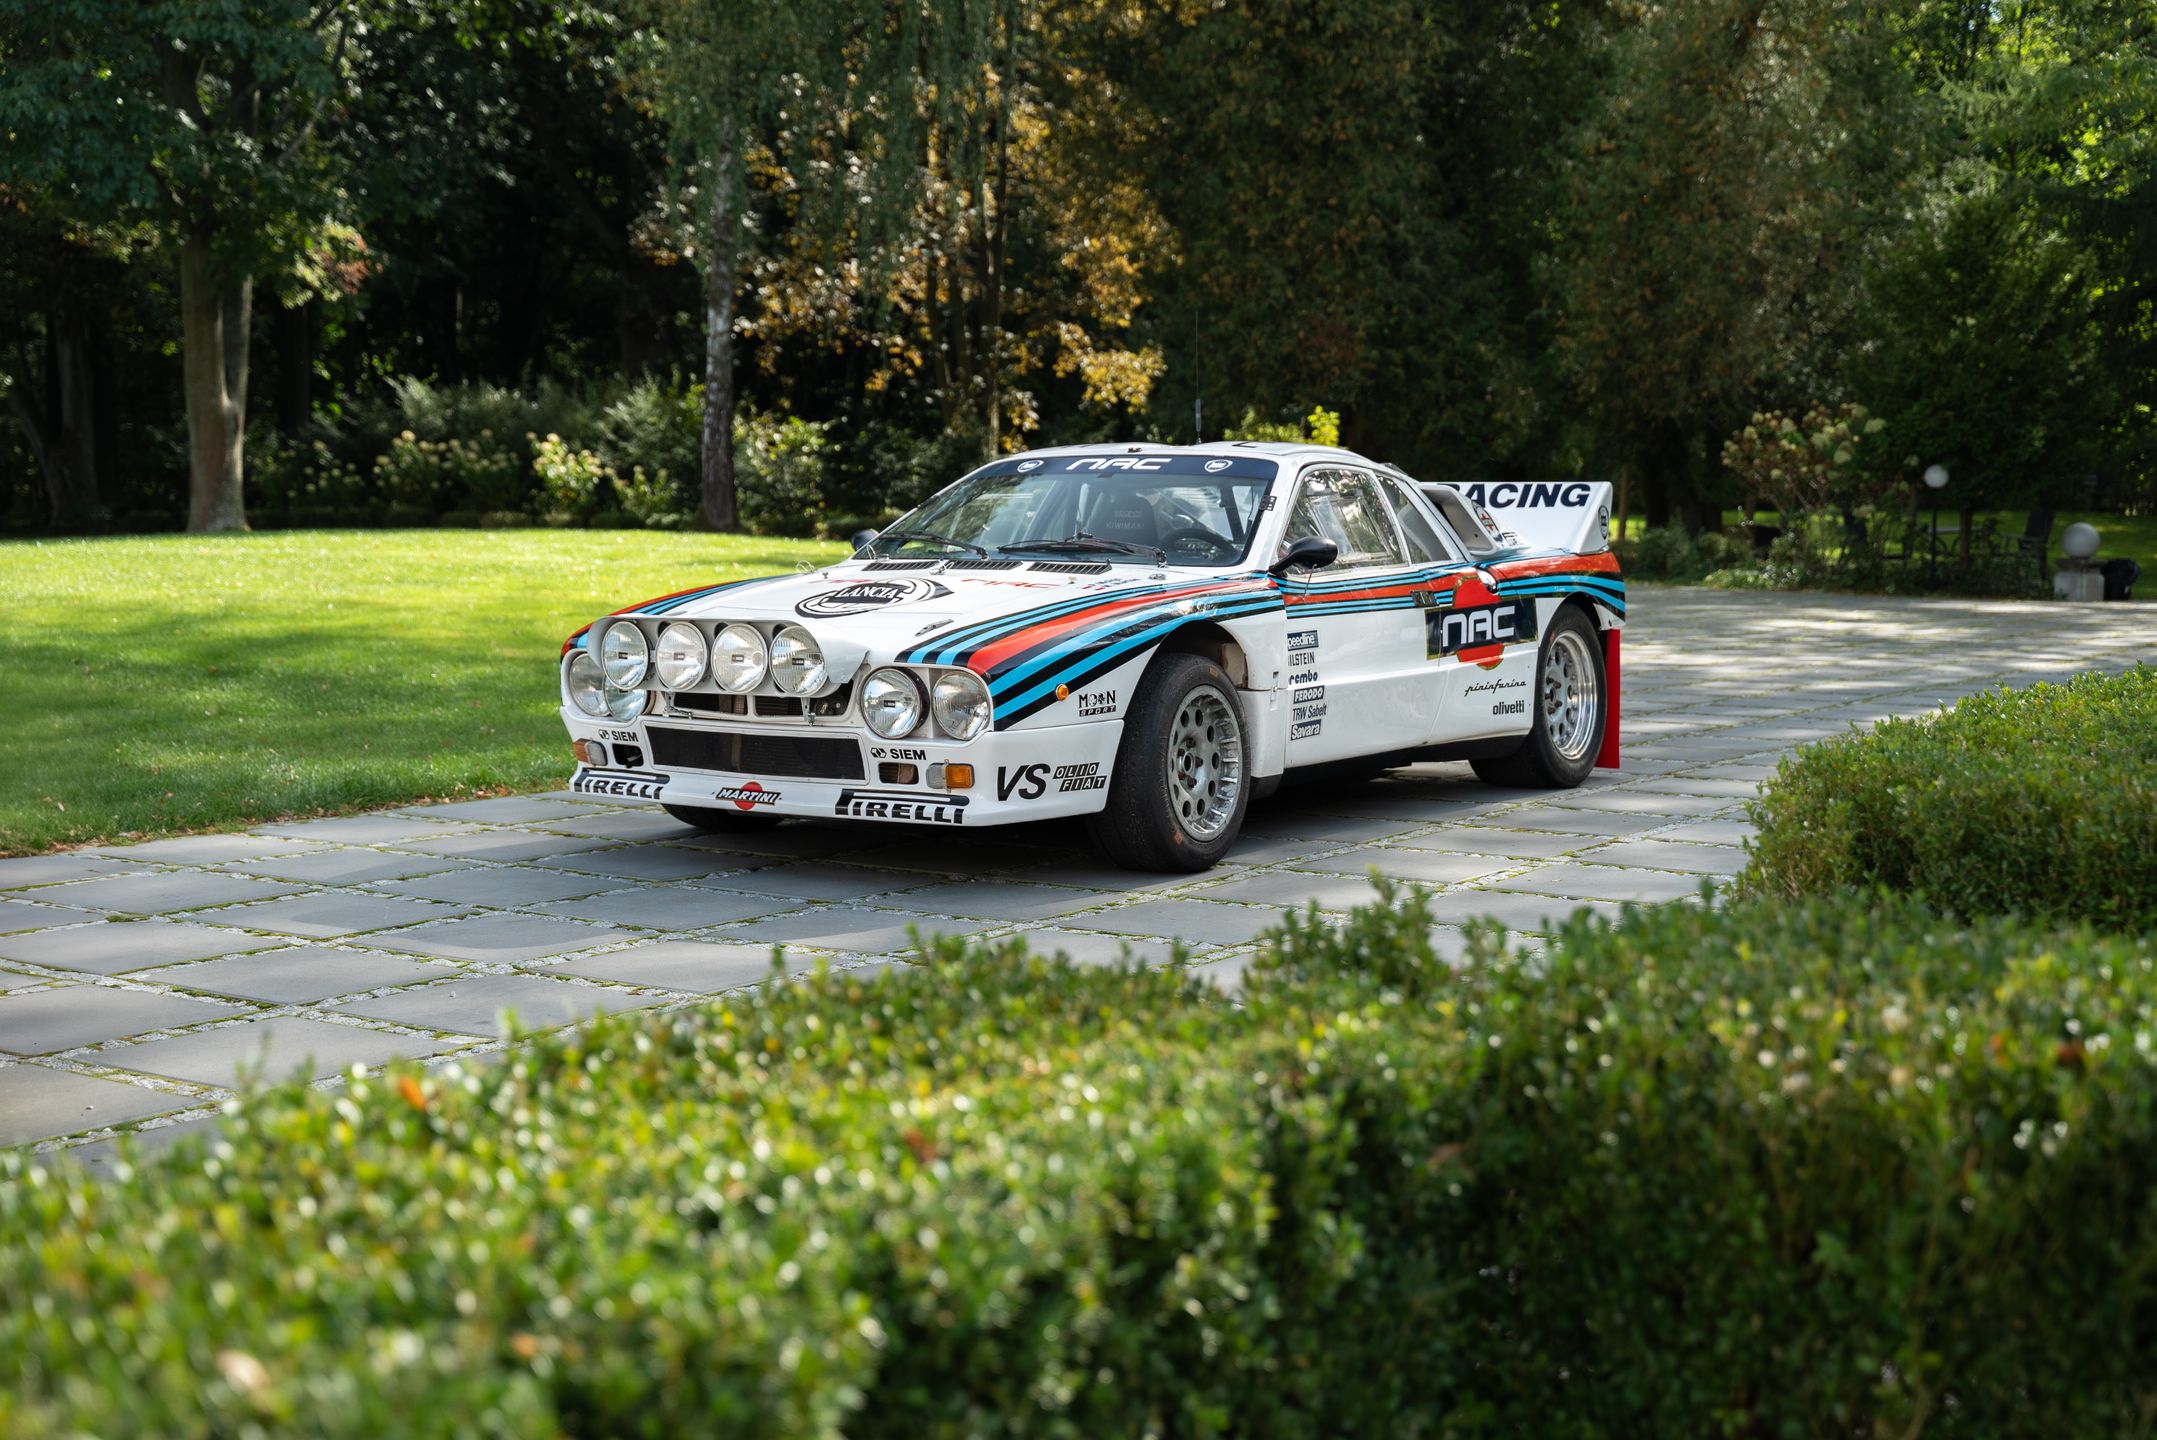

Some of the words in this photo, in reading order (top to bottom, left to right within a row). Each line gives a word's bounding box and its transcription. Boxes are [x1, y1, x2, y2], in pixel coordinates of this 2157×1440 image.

[837, 586, 899, 599] LANCIA
[1288, 652, 1315, 666] ILSTEIN
[1294, 687, 1323, 702] FERODO
[1464, 678, 1527, 697] pininfarina
[1080, 705, 1116, 717] SPORT
[1293, 705, 1307, 721] TRW
[1492, 700, 1526, 716] olivetti
[612, 730, 639, 742] SIEM
[1292, 724, 1320, 739] Savara
[891, 748, 927, 761] SIEM
[1054, 763, 1099, 779] OLIO
[574, 767, 670, 799] PIRELLI
[997, 763, 1051, 802] VS
[1060, 776, 1106, 792] FIAT
[718, 787, 781, 805] MARTINI
[835, 788, 969, 824] PIRELLI
